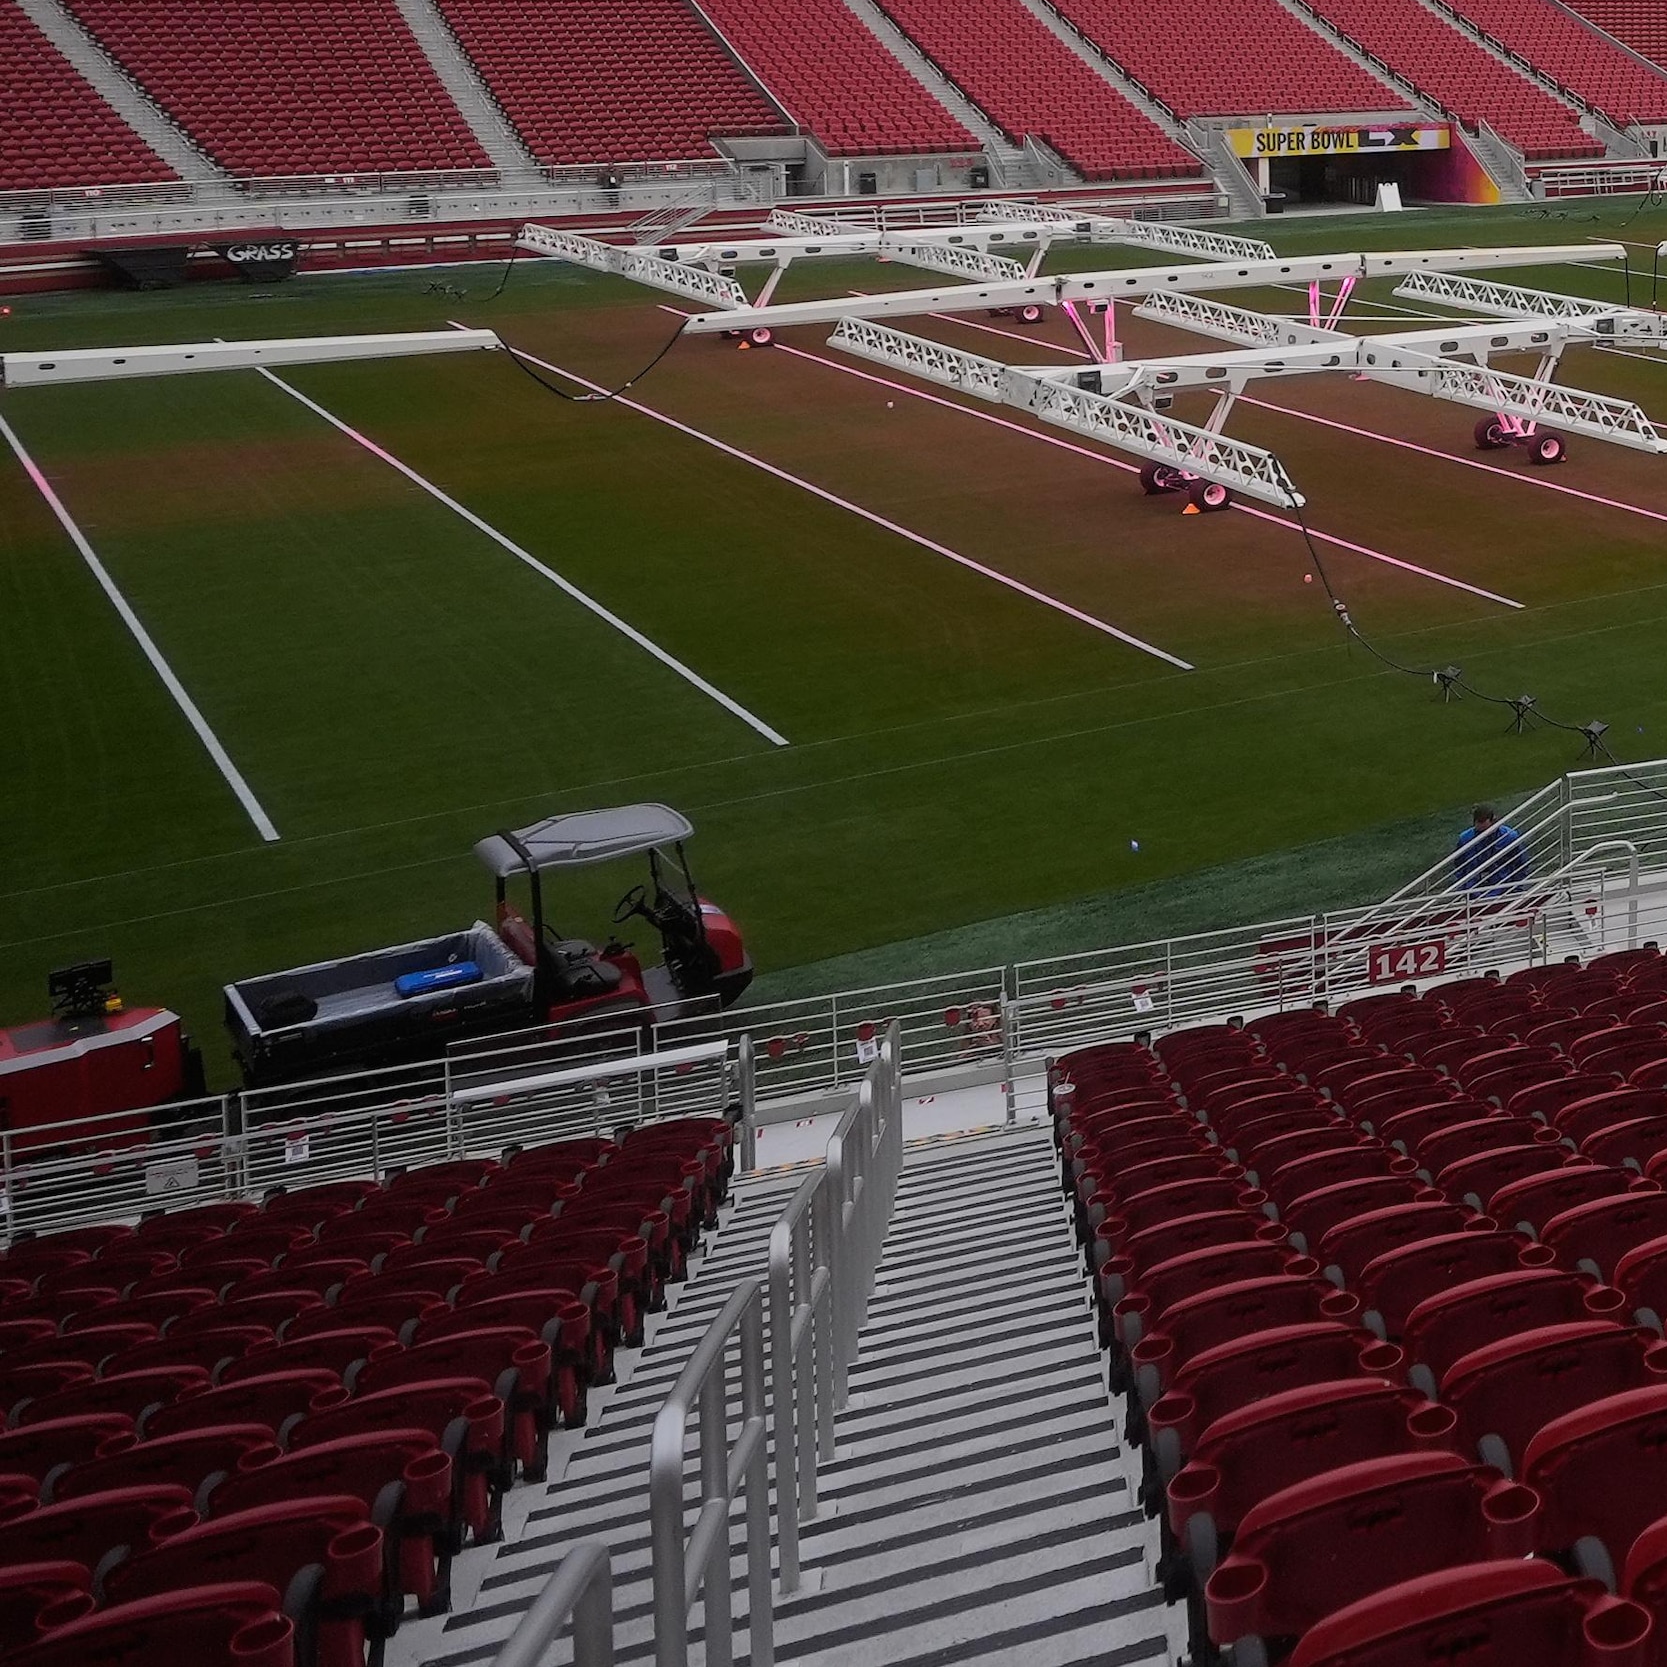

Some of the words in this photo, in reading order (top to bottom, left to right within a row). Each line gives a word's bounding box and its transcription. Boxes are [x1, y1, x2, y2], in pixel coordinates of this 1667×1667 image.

[1256, 132, 1306, 153] SUPER
[1311, 131, 1354, 150] BOWL
[1357, 128, 1420, 147] LX
[226, 243, 295, 262] GRASS
[1374, 945, 1440, 981] 142
